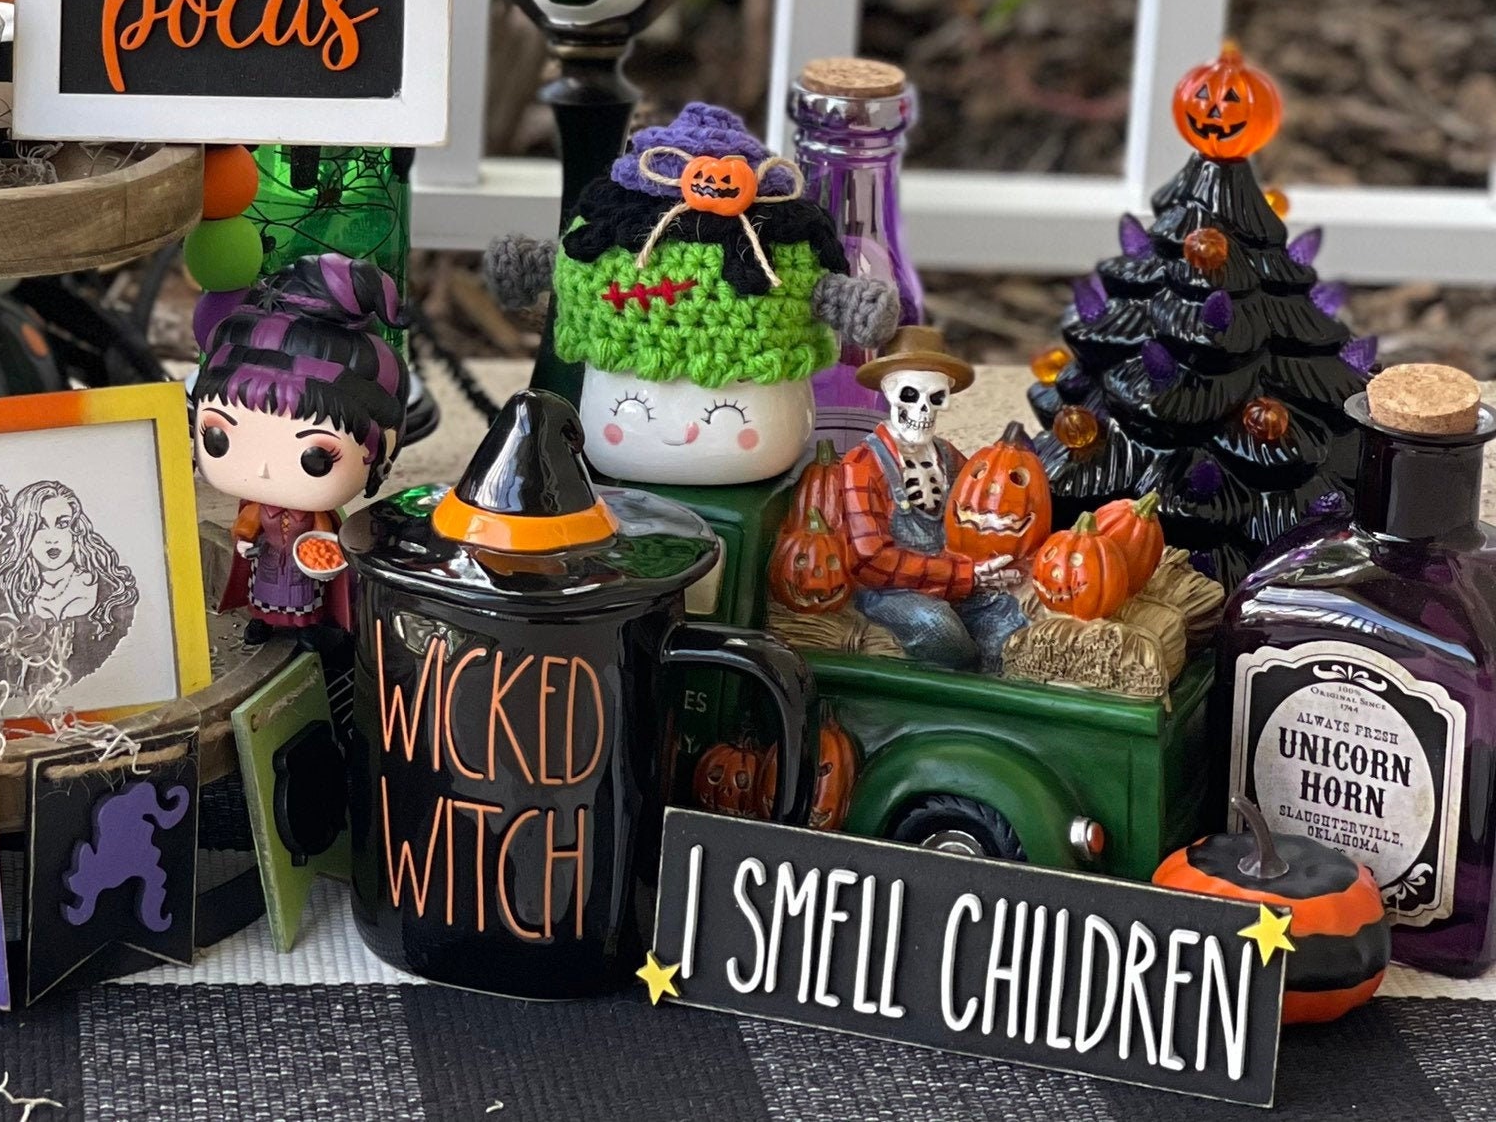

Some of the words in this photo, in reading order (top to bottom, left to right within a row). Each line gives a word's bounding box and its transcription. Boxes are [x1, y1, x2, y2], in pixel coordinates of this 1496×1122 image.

[376, 619, 605, 785] WICKED
[1297, 712, 1350, 734] ALWAYS
[1355, 724, 1399, 746] FRESH
[1279, 727, 1412, 787] UNICORN
[1299, 769, 1386, 819] HORN
[1279, 804, 1404, 848] SLAUGHTERVILLE,
[1307, 825, 1380, 854] OKLAHOMA
[381, 776, 585, 940] WITCH
[681, 844, 703, 978] I
[726, 857, 906, 1019] SMELL
[940, 893, 1253, 1080] CHILDREN
